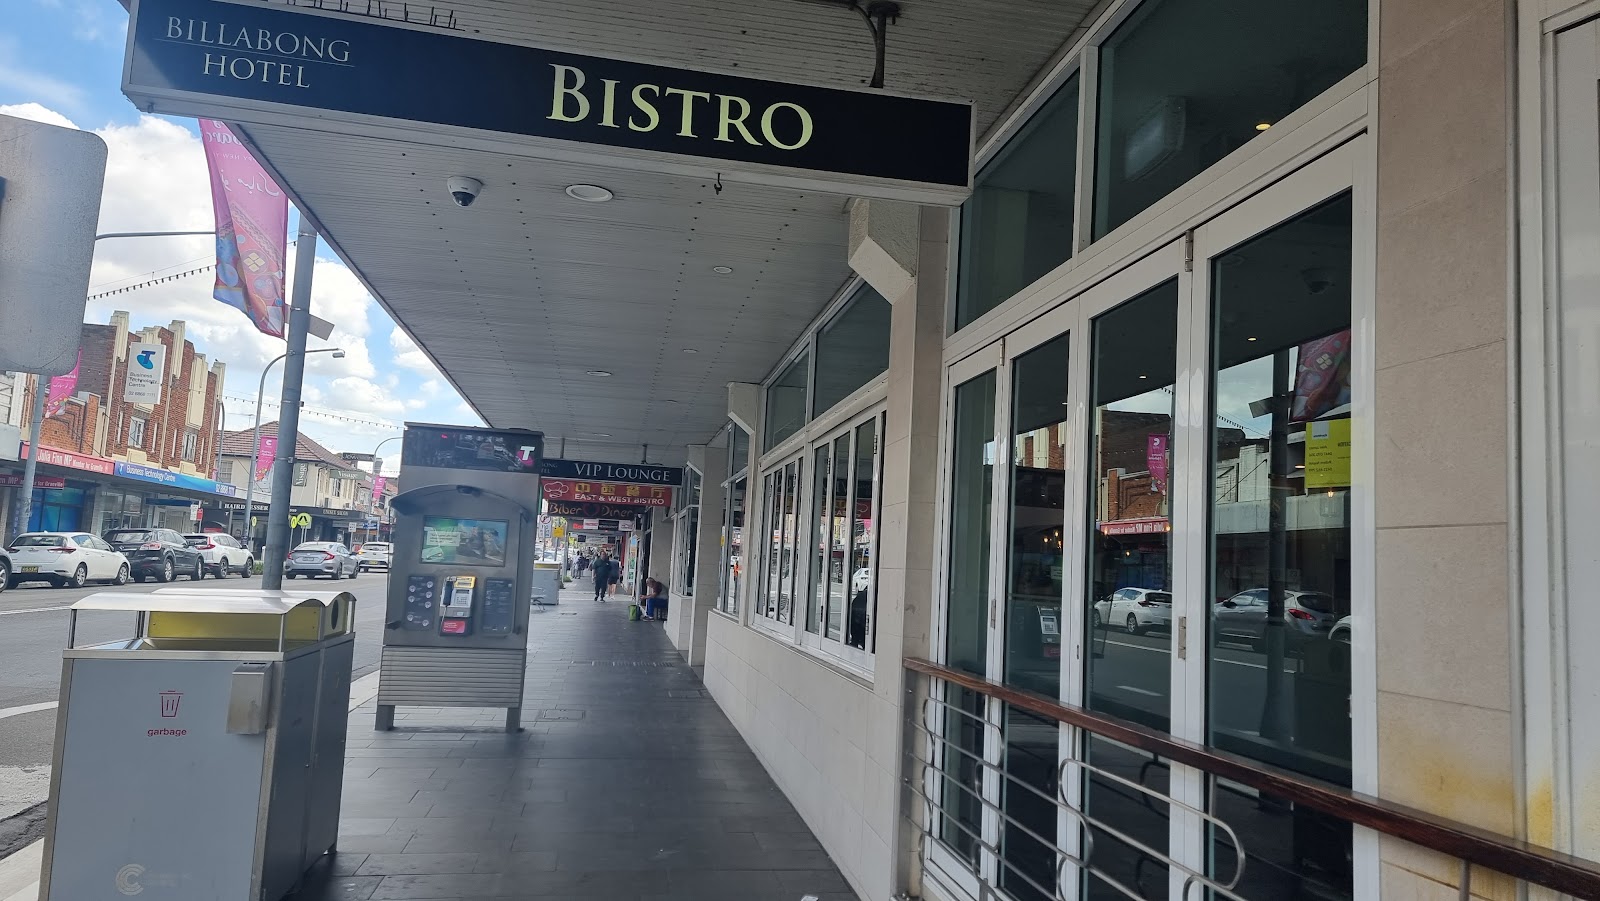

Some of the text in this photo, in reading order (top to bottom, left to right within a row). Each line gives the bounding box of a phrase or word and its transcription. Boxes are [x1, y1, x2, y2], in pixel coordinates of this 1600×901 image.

[166, 16, 350, 62] BILLABONG
[203, 53, 310, 88] HOTEL
[546, 63, 813, 150] BISTRO
[130, 371, 153, 379] Business
[37, 449, 51, 462] Julia
[52, 452, 63, 465] Finn
[64, 455, 73, 466] MP
[126, 464, 144, 478] Business
[144, 468, 164, 483] Technology
[164, 473, 176, 483] Centre
[296, 463, 307, 486] Visage
[338, 470, 358, 479] Visage
[574, 463, 670, 481] VIP LOUNGE
[574, 493, 597, 501] EAST
[607, 495, 632, 503] WEST
[224, 503, 269, 511] HAIRDESSER
[549, 502, 634, 517] Biber Diner
[147, 728, 187, 737] garbage
